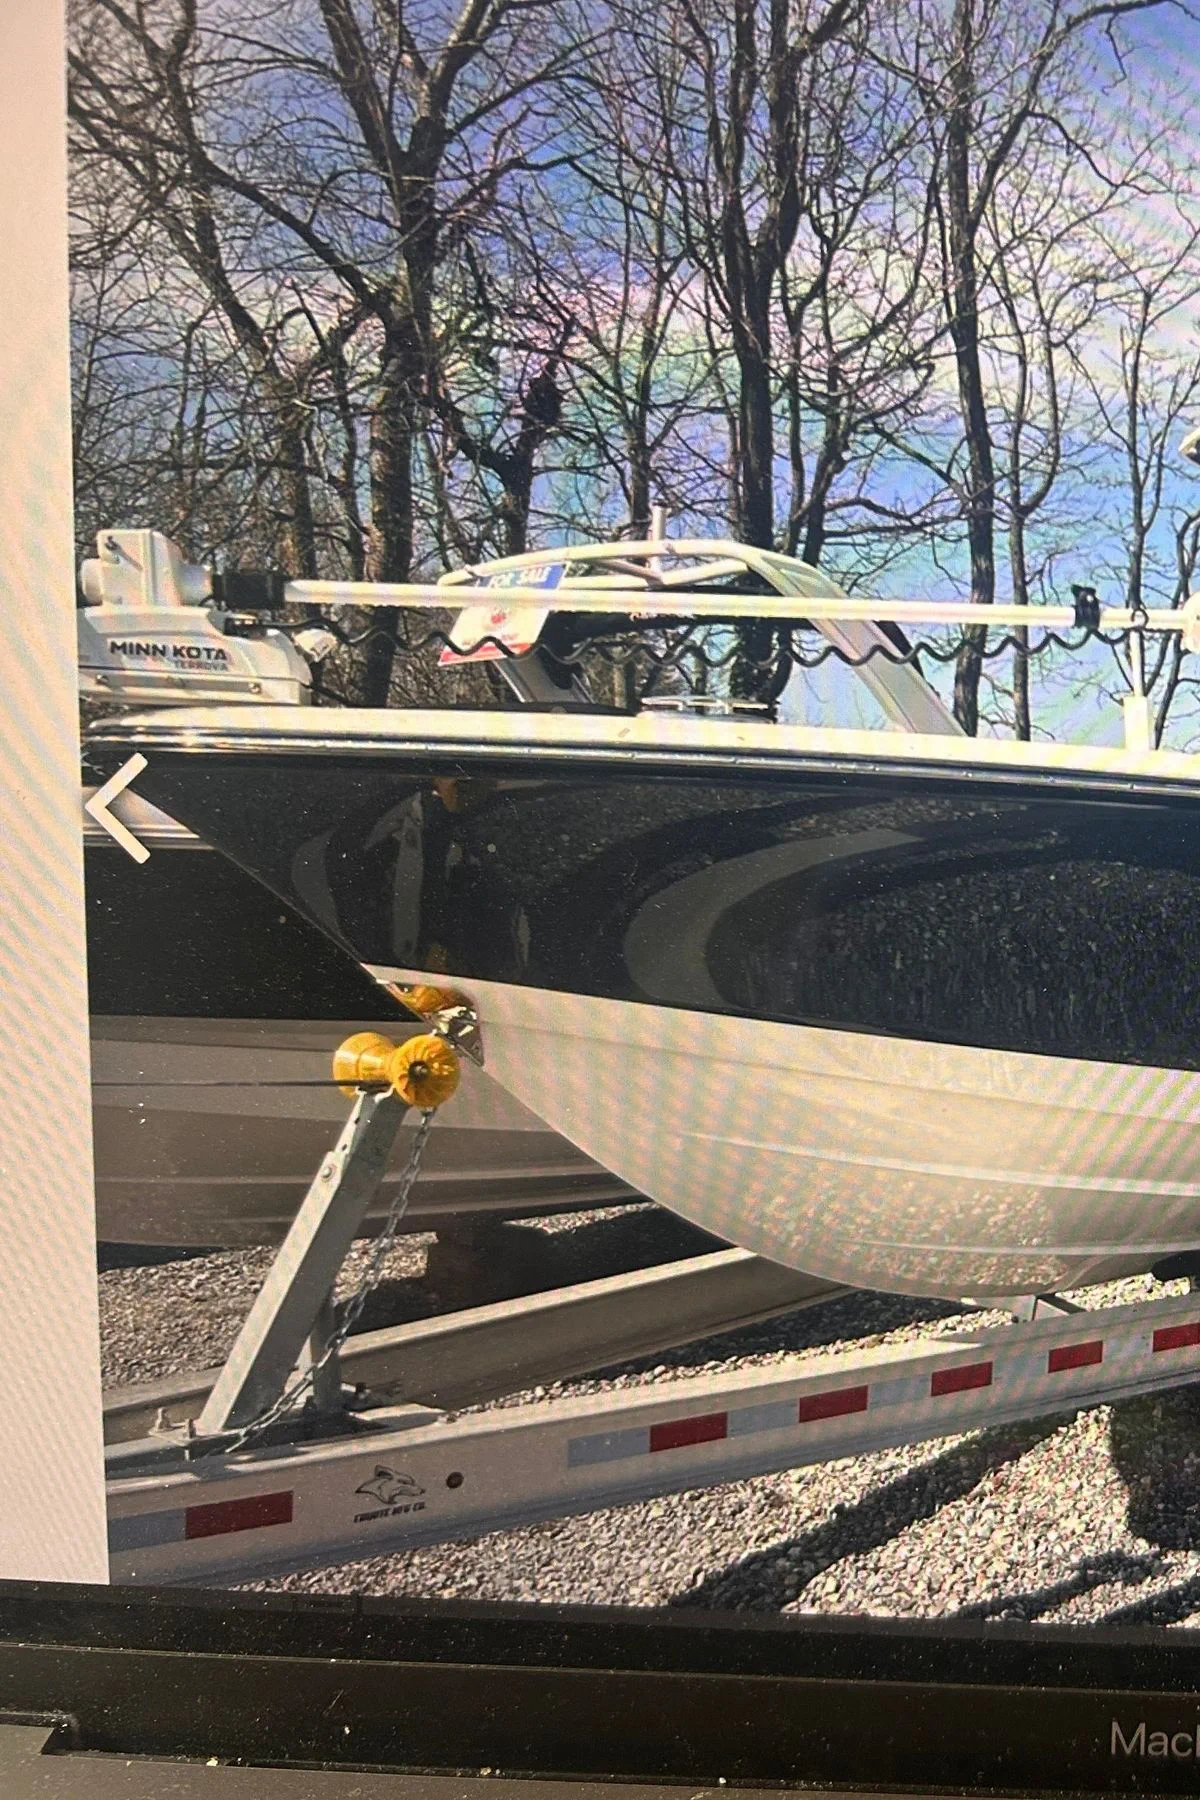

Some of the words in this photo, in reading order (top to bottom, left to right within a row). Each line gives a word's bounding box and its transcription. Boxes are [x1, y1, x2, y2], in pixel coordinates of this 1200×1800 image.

[517, 566, 552, 584] SALE
[110, 640, 167, 657] MINN
[172, 644, 229, 661] KOTA
